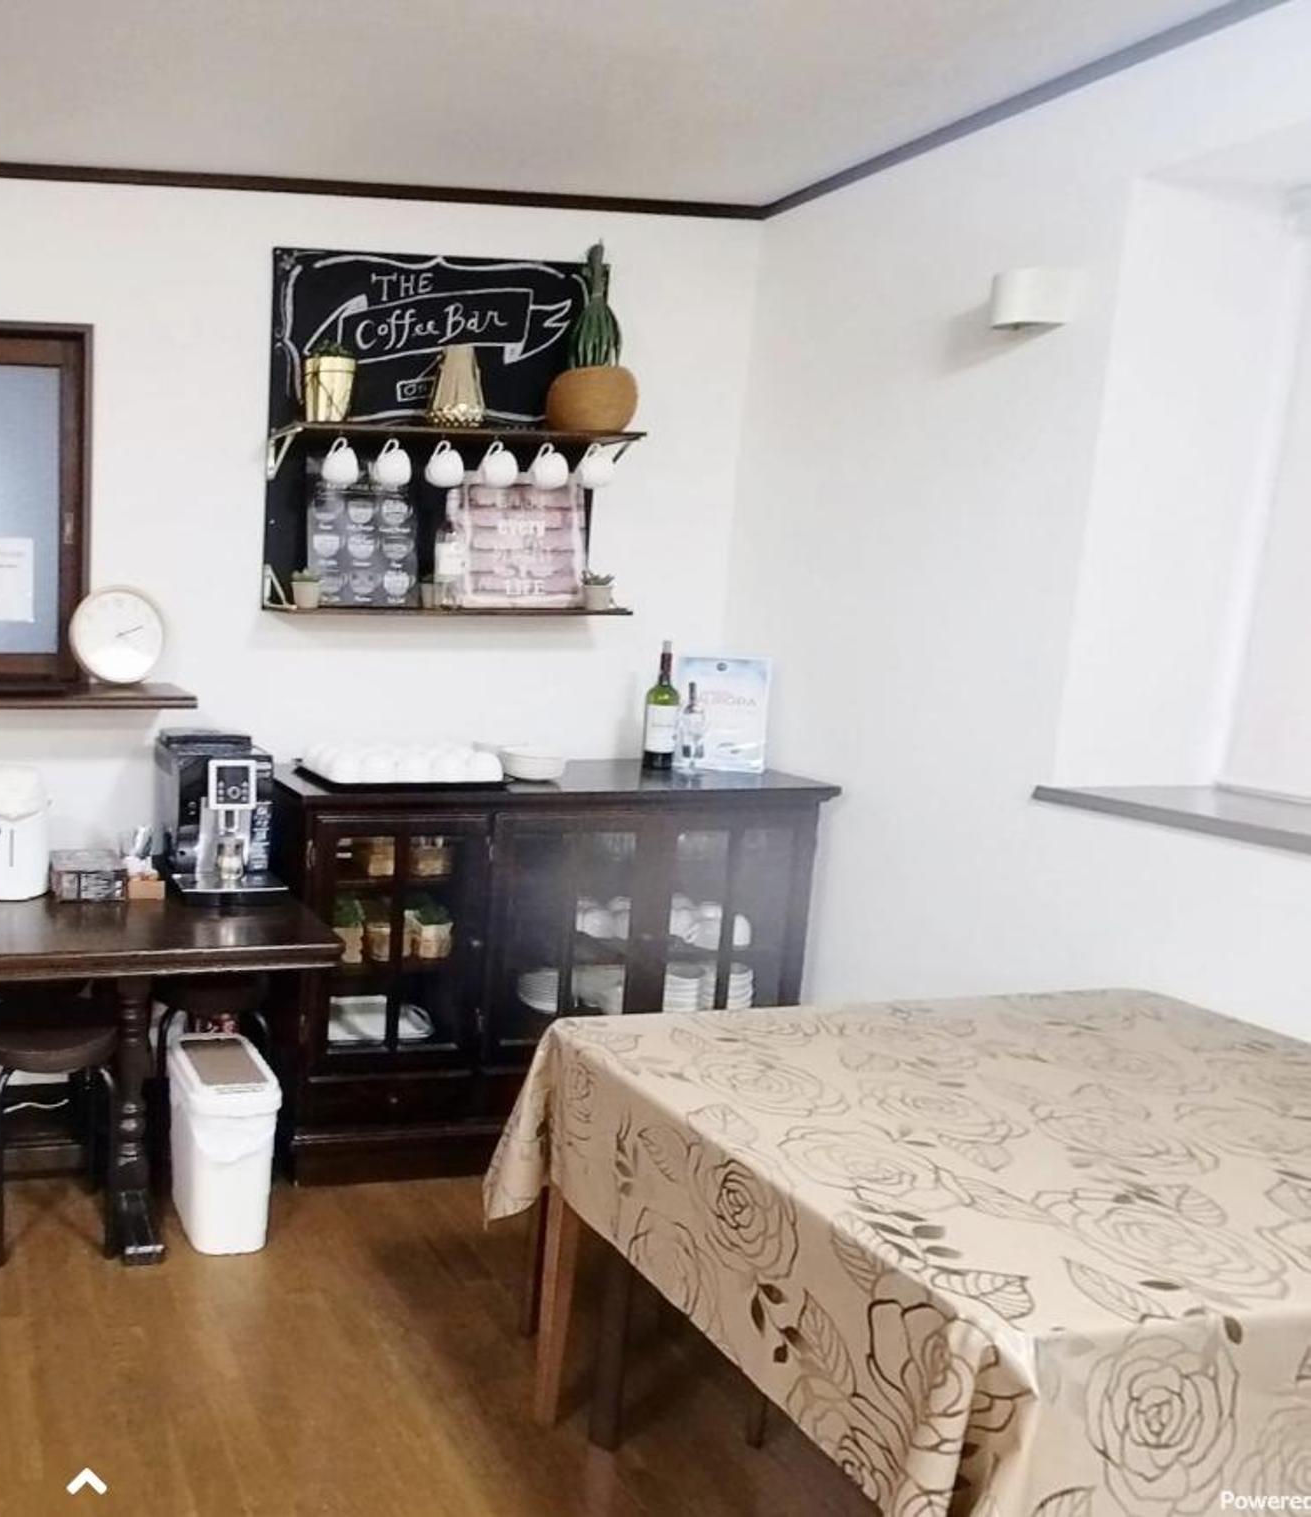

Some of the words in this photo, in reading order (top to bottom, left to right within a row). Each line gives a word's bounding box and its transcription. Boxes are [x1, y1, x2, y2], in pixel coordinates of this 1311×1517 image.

[371, 272, 434, 301] THE
[356, 309, 440, 350] Coffee
[438, 303, 508, 343] Bar
